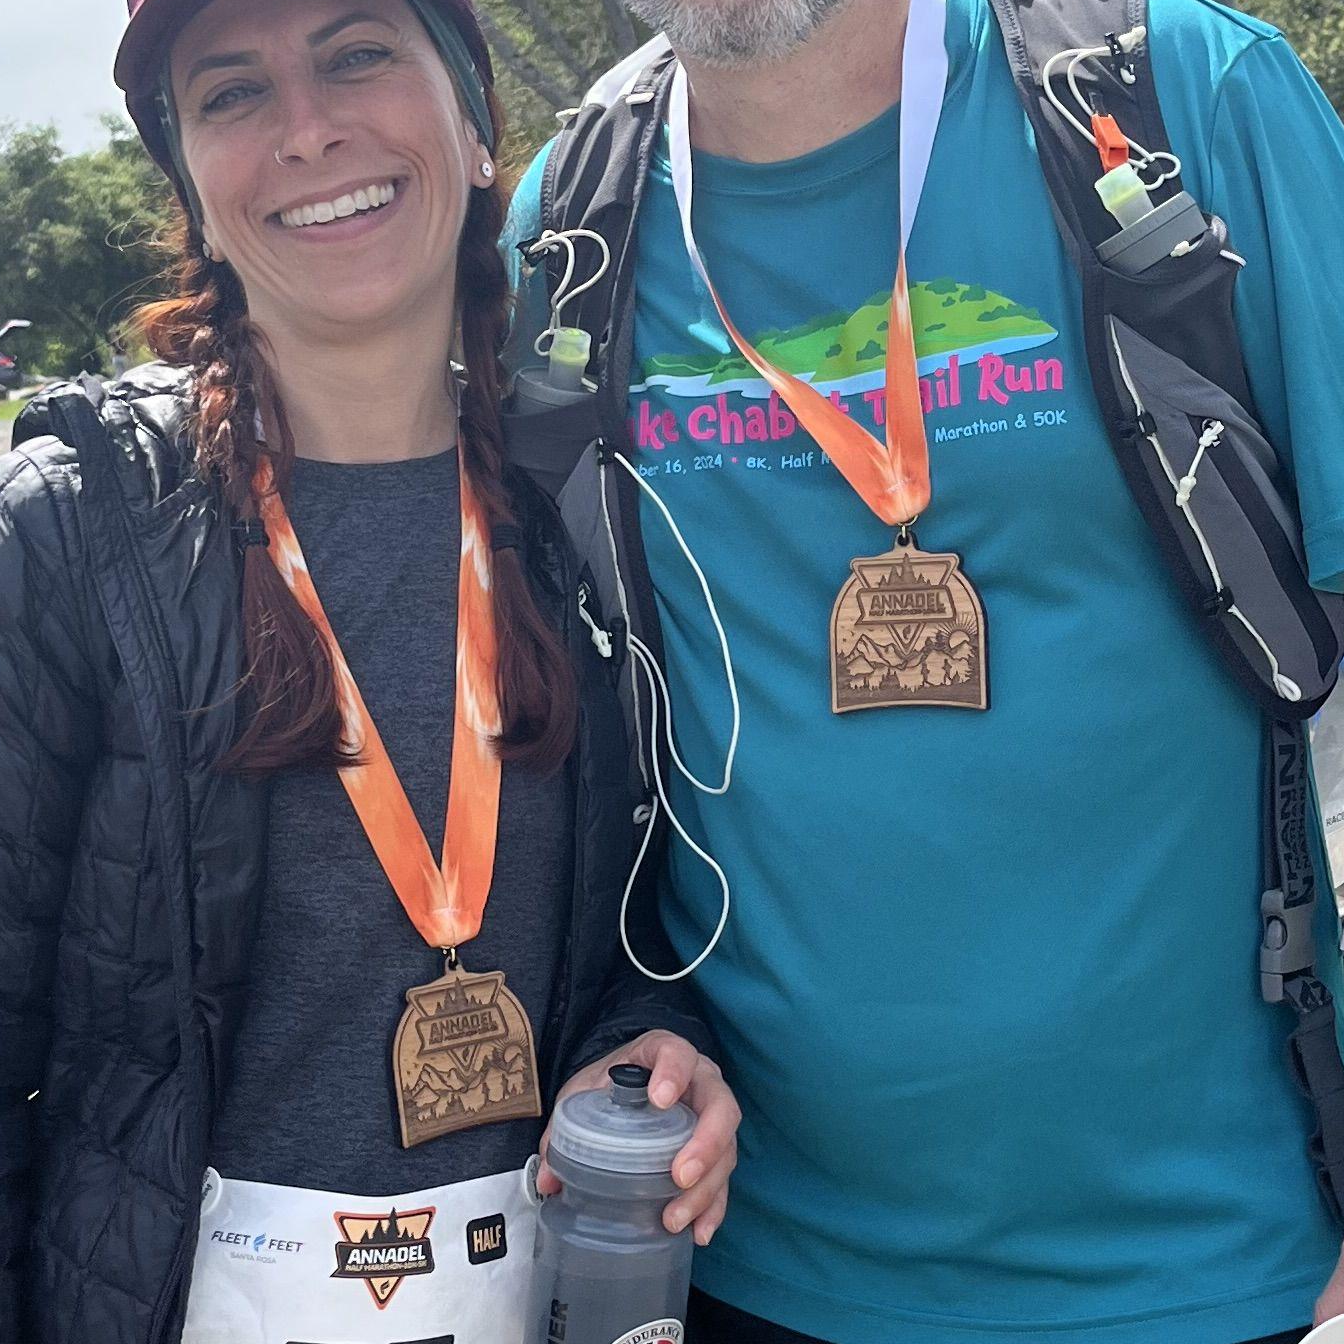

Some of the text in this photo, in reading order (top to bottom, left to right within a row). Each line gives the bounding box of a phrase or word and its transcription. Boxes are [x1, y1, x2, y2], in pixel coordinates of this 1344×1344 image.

[977, 352, 1064, 406] Run
[664, 459, 687, 475] 16,
[693, 453, 723, 472] 2024
[745, 455, 773, 471] 8K,
[780, 451, 814, 469] Half
[934, 418, 1008, 444] Marathon
[1014, 413, 1028, 429] &
[1033, 408, 1069, 428] 50K
[870, 591, 946, 610] ANNADEL
[429, 1010, 497, 1038] ANNADEL
[210, 1230, 304, 1253] FLEET FEET
[472, 1223, 503, 1254] HALF
[347, 1244, 427, 1265] ANNADEL
